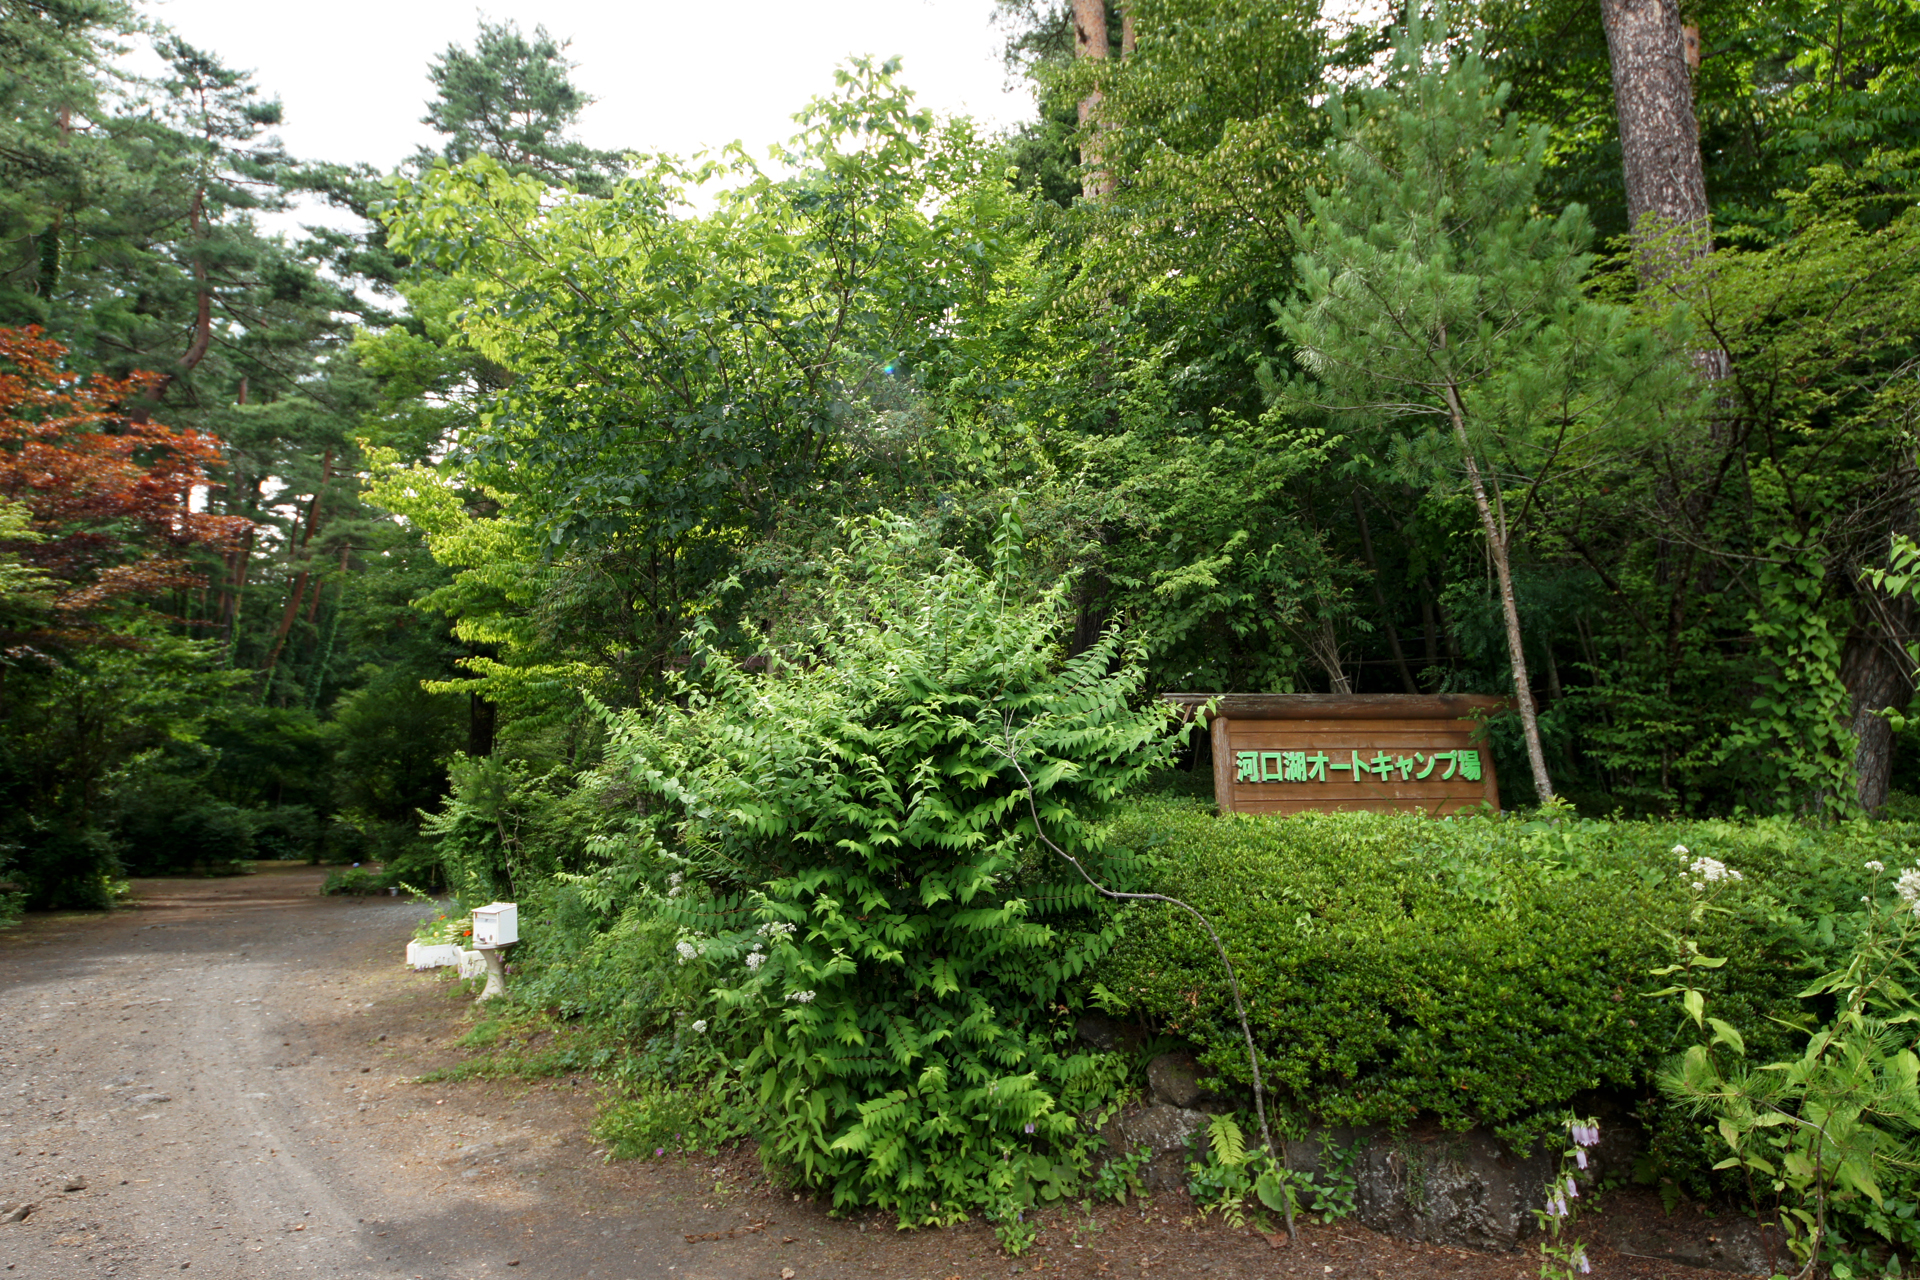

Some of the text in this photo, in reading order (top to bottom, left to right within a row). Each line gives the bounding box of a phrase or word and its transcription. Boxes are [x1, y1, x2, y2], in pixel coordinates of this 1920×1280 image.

[1236, 750, 1481, 782] 河口湖オートキャンプ場
